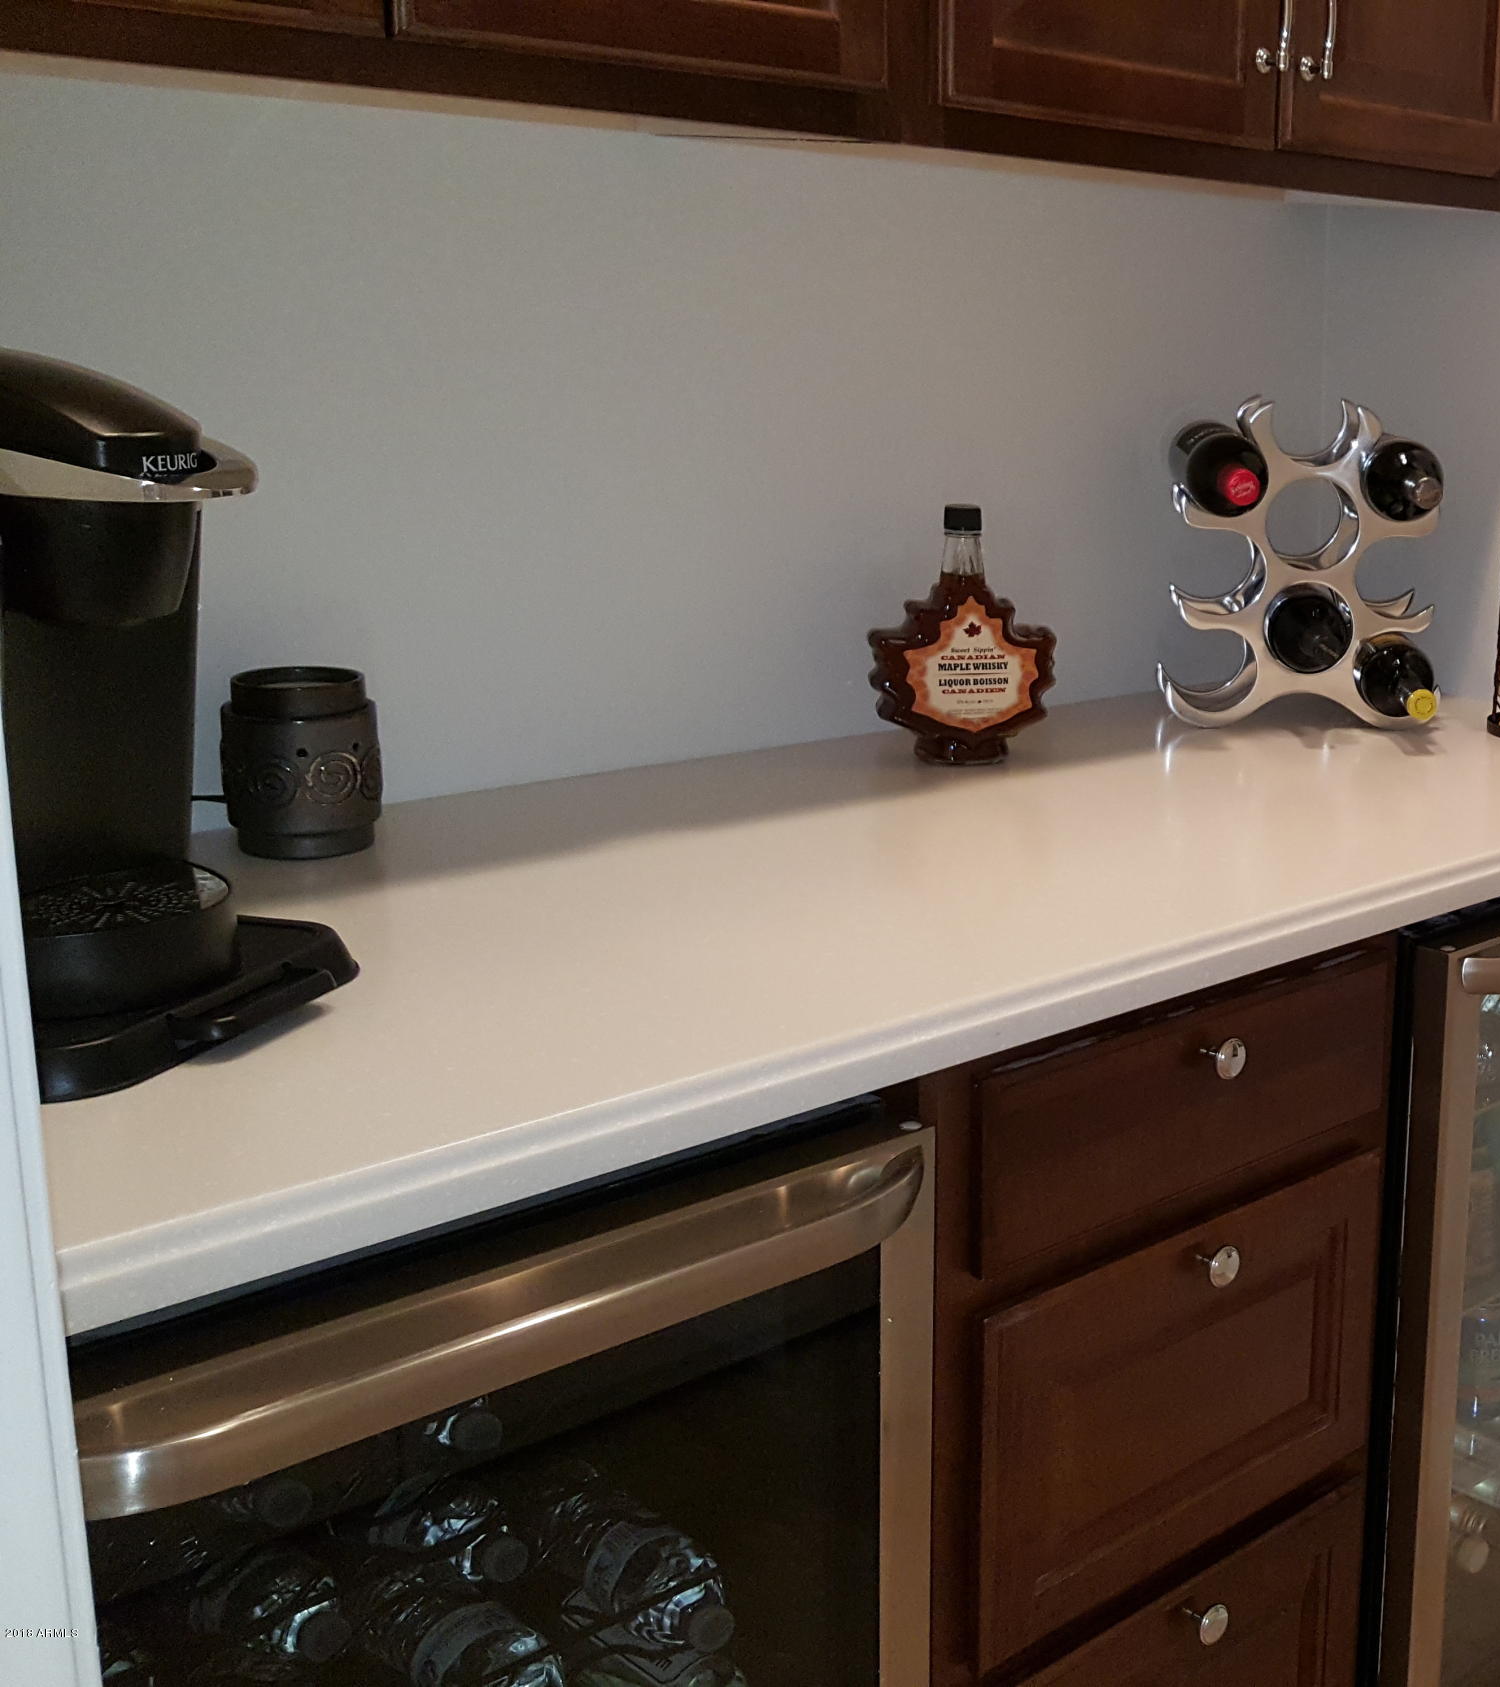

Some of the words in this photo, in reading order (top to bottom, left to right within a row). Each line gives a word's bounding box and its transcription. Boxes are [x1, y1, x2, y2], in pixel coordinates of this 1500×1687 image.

[142, 452, 198, 472] KEURIG
[938, 662, 972, 672] MAPLE
[973, 661, 1009, 671] WHISKY
[938, 677, 971, 688] LIQUOR
[972, 676, 1009, 686] BOISSON
